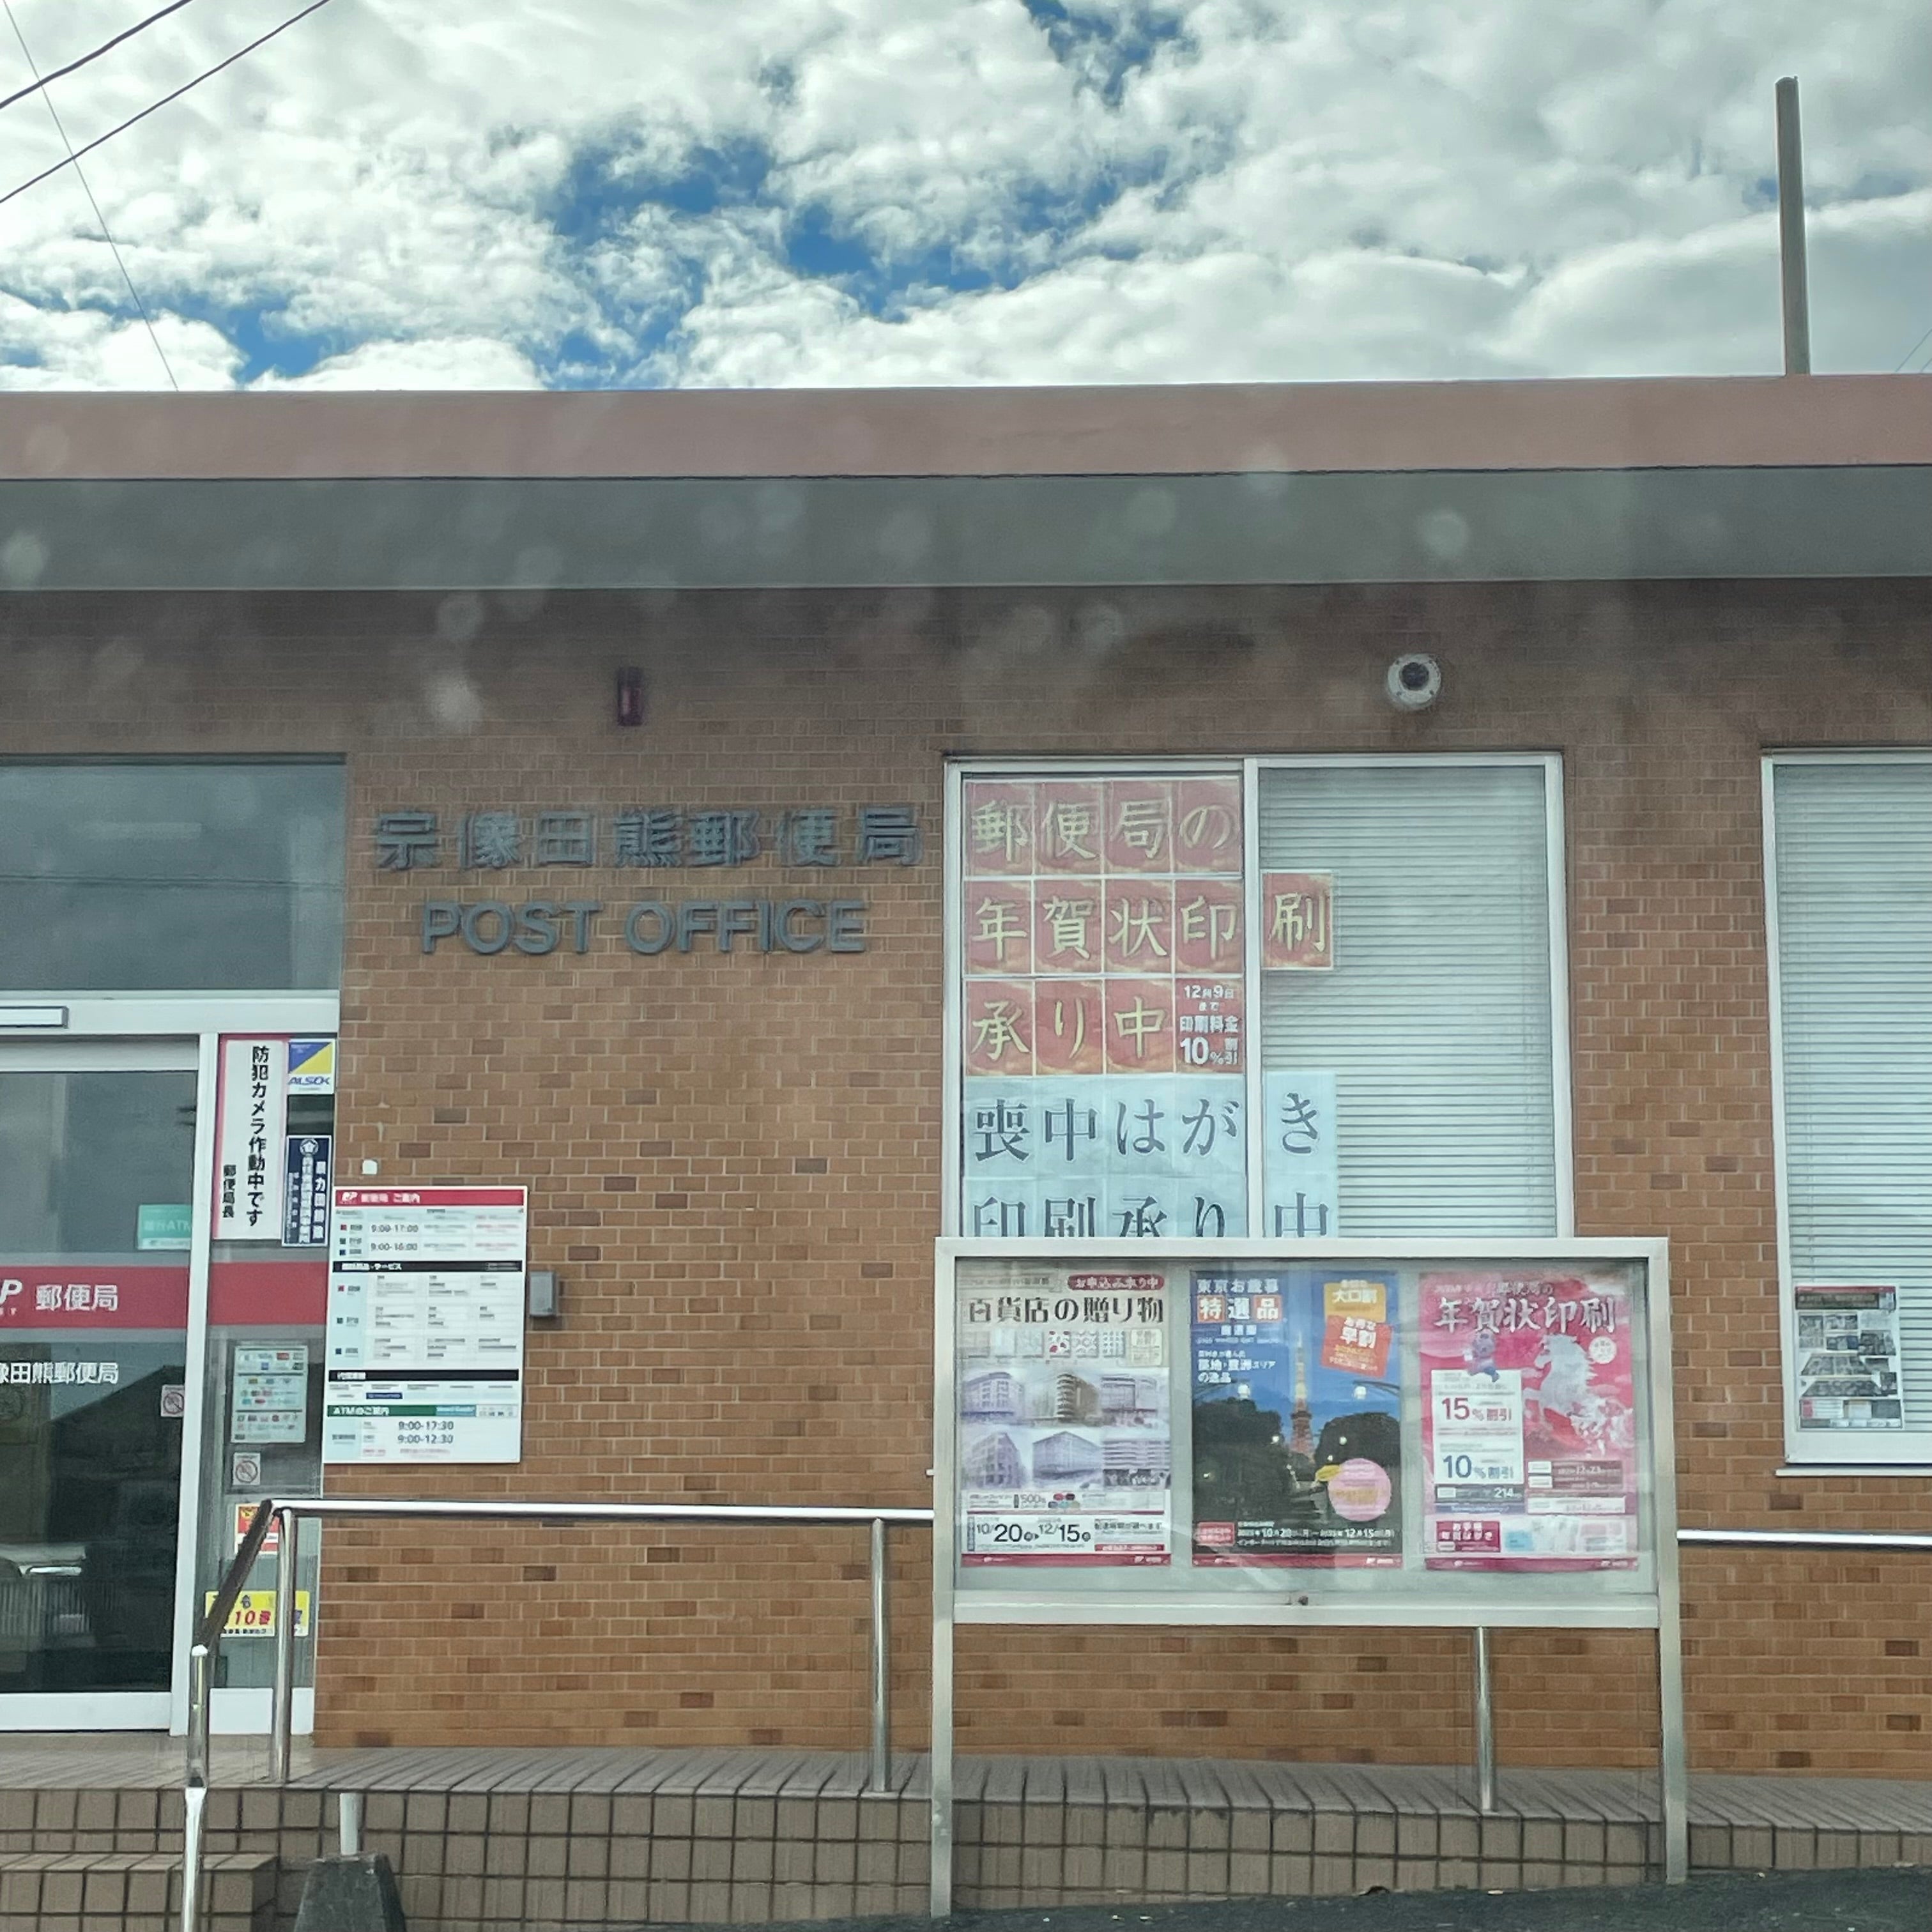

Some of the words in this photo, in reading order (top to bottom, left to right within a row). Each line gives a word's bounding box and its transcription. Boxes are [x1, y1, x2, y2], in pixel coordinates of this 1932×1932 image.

[375, 806, 922, 870] 宗像田熊郵便局
[971, 799, 1239, 862] 郵便局の
[422, 900, 602, 956] POST
[624, 900, 866, 955] OFFICE
[971, 893, 1328, 962] 年賀状印刷
[1184, 985, 1234, 999] 12月9日
[971, 995, 1169, 1061] 承り中
[287, 1076, 330, 1085] ALSOK
[246, 1045, 270, 1227] 防犯カメラ作動中です
[974, 1092, 1320, 1163] 喪中はがき
[974, 1192, 1329, 1238] 印刷承り中
[36, 1284, 118, 1312] 郵便局
[968, 1296, 1165, 1324] 百貨店の贈り物
[1434, 1296, 1616, 1333] 年賀状印刷
[1441, 1397, 1512, 1420] 15%割引
[1443, 1455, 1514, 1479] 10%割引
